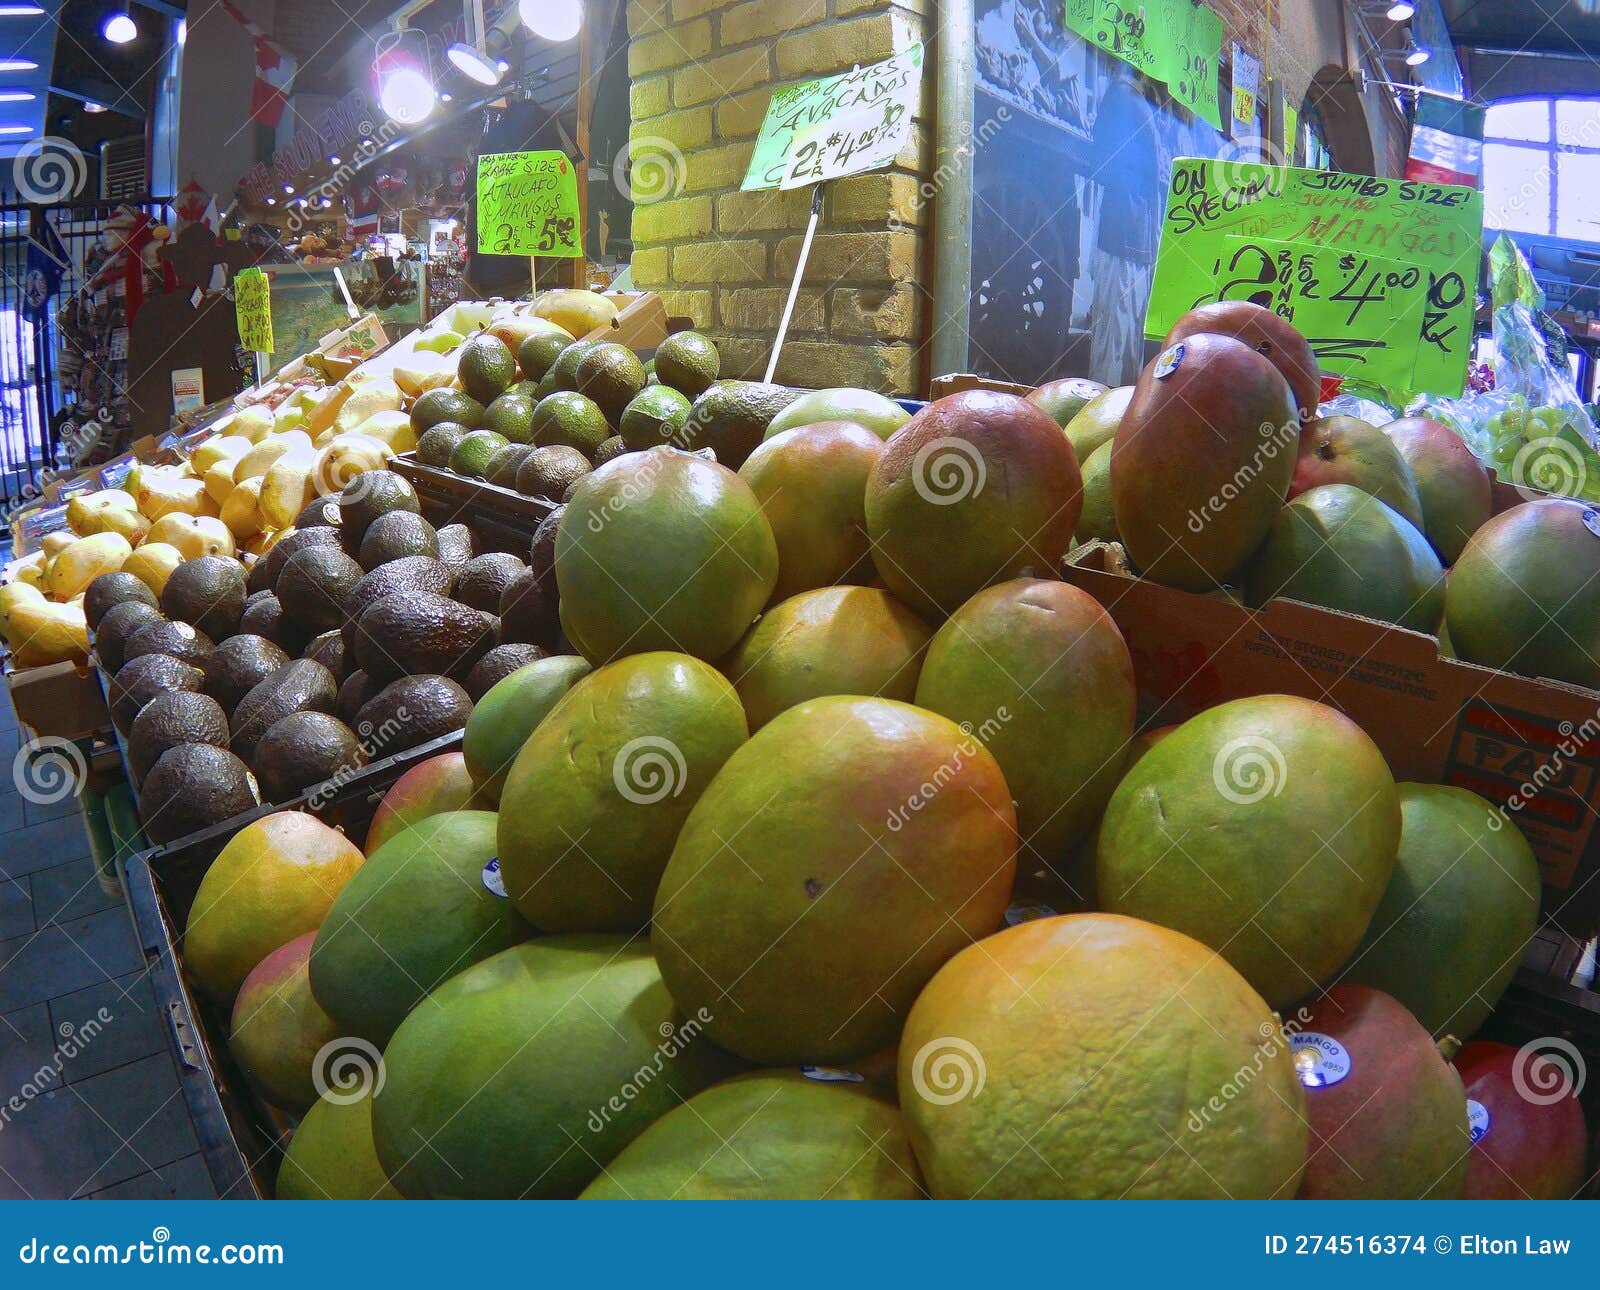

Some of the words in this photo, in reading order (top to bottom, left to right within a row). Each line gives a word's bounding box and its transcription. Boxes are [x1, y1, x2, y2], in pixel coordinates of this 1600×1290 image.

[791, 141, 818, 181] 2
[1172, 162, 1207, 197] ON
[1302, 172, 1389, 198] JUMBO
[1294, 1036, 1340, 1056] MANGO
